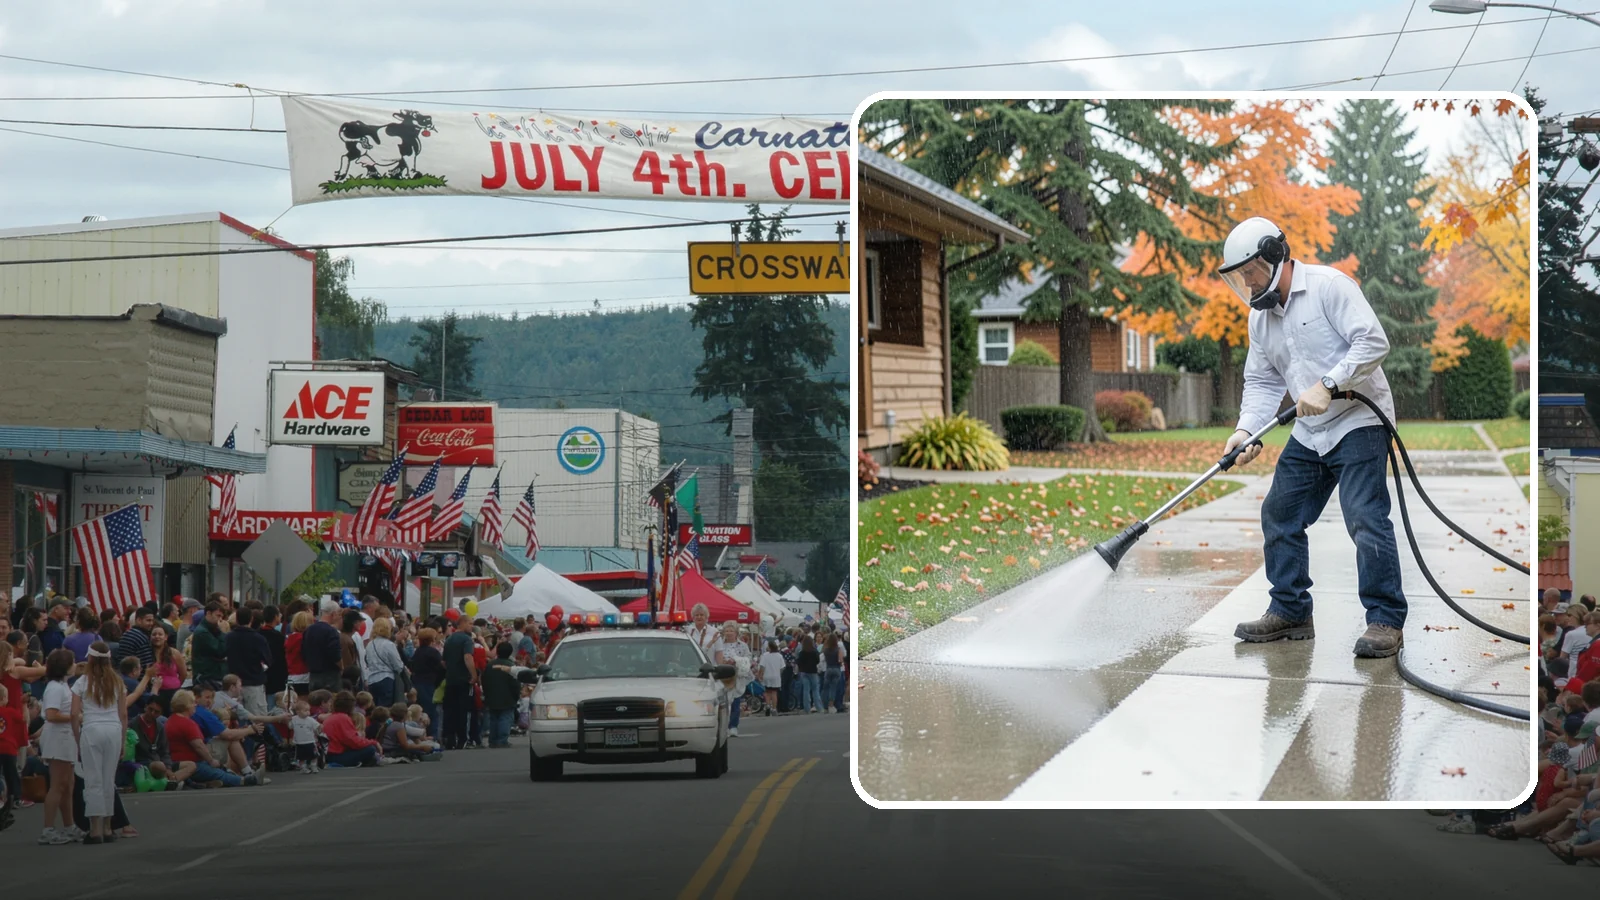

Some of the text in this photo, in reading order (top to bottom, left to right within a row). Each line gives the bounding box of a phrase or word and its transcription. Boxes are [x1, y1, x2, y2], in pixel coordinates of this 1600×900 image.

[481, 141, 605, 192] JULY
[632, 150, 746, 198] 4th.
[697, 254, 850, 280] CROSSWA
[283, 380, 373, 420] ACE
[406, 409, 485, 422] CEDAR LOG
[283, 421, 370, 436] Hardware
[416, 428, 477, 447] Coca-Cola
[95, 485, 125, 495] Vincent
[126, 486, 136, 495] de
[137, 486, 155, 496] Paul
[688, 526, 741, 535] CRNATION
[699, 535, 730, 543] GLASS
